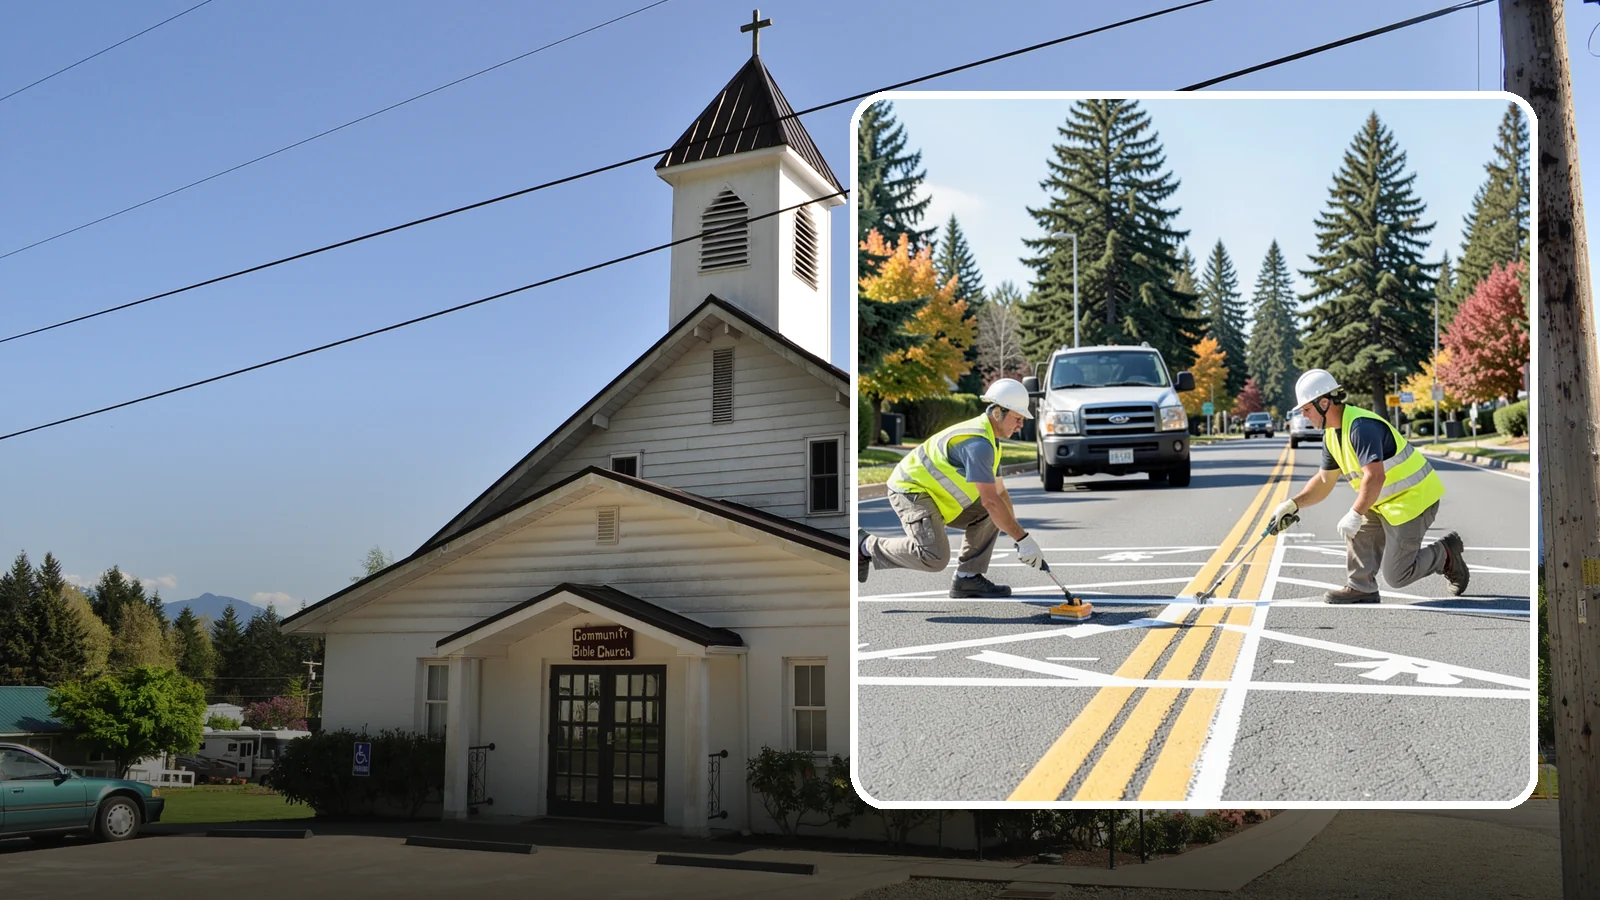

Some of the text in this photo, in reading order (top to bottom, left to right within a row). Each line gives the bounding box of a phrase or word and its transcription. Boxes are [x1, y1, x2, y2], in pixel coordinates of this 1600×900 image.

[574, 627, 628, 642] Community
[572, 644, 631, 658] Bible Church
